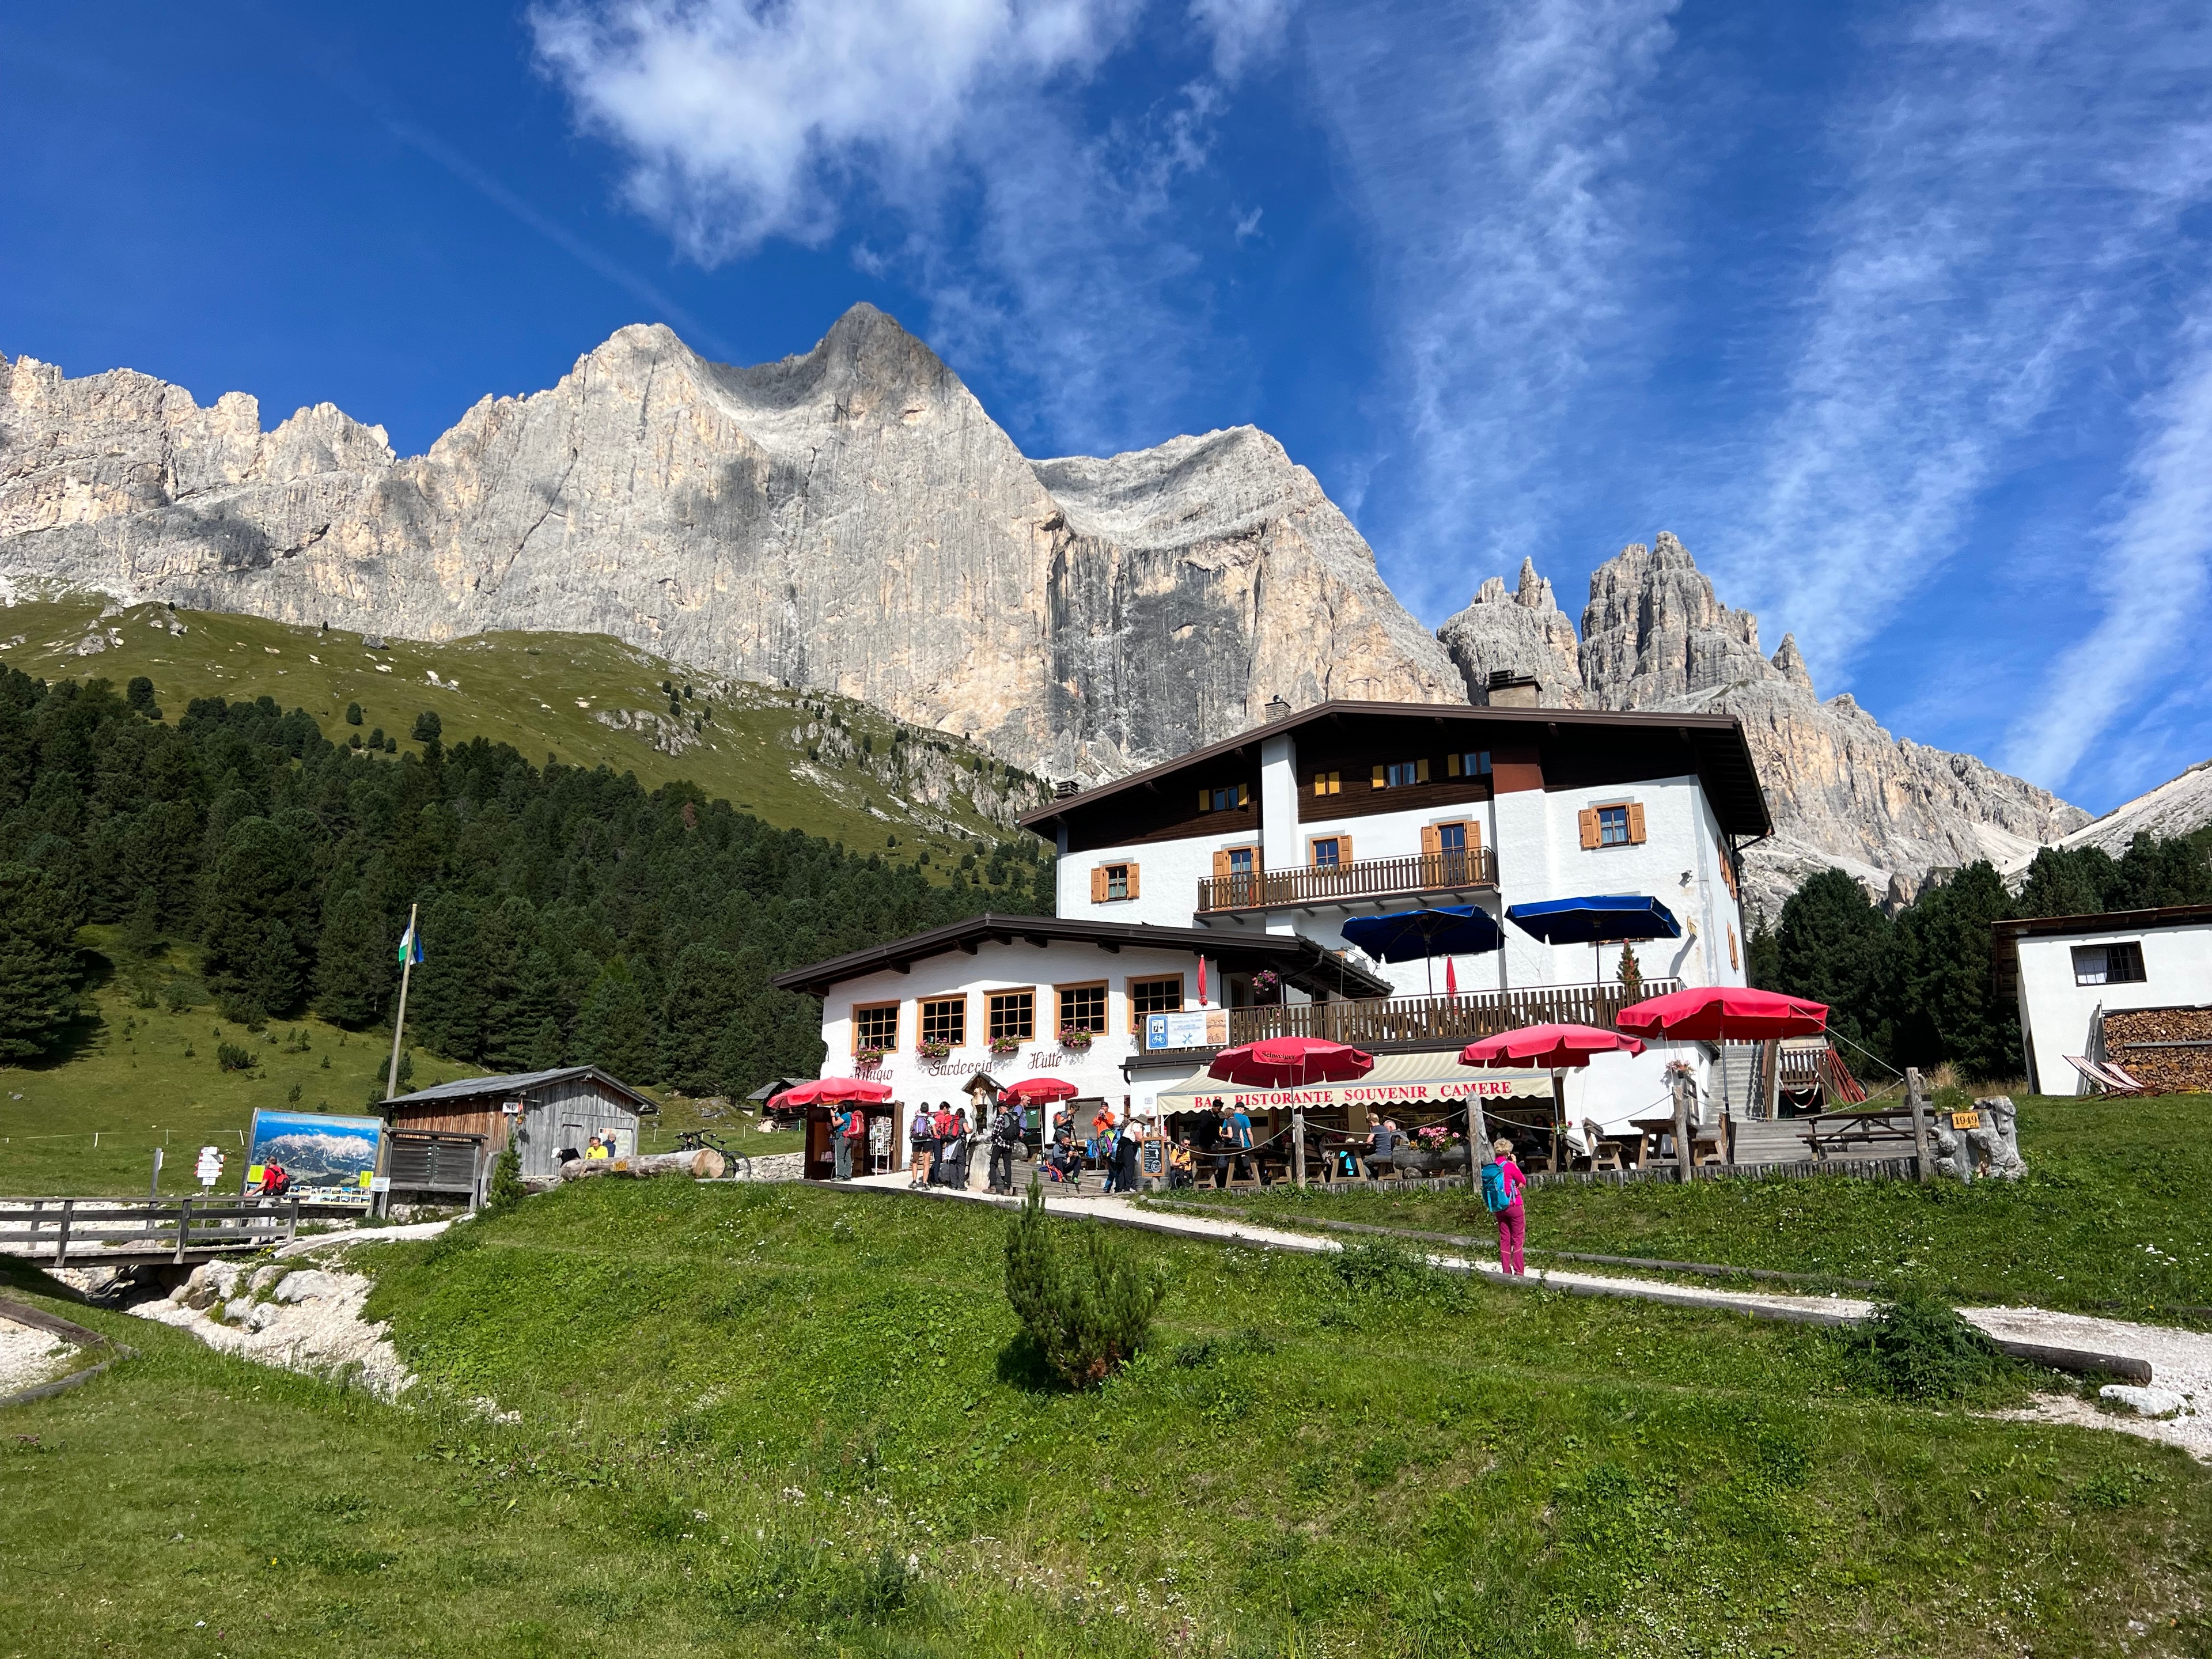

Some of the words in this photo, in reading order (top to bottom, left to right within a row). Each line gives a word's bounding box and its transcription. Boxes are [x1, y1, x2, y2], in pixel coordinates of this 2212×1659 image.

[1262, 1051, 1296, 1060] Schweiger
[850, 1065, 894, 1084] Rifugio
[929, 1059, 993, 1076] Gardeccia
[1028, 1051, 1062, 1069] Hütte
[1235, 1091, 1334, 1105] RISTORANTE
[1344, 1086, 1428, 1101] SOUVENIR
[1441, 1082, 1512, 1097] CAMERE
[506, 1103, 516, 1111] WC
[1955, 1115, 1978, 1124] 1949
